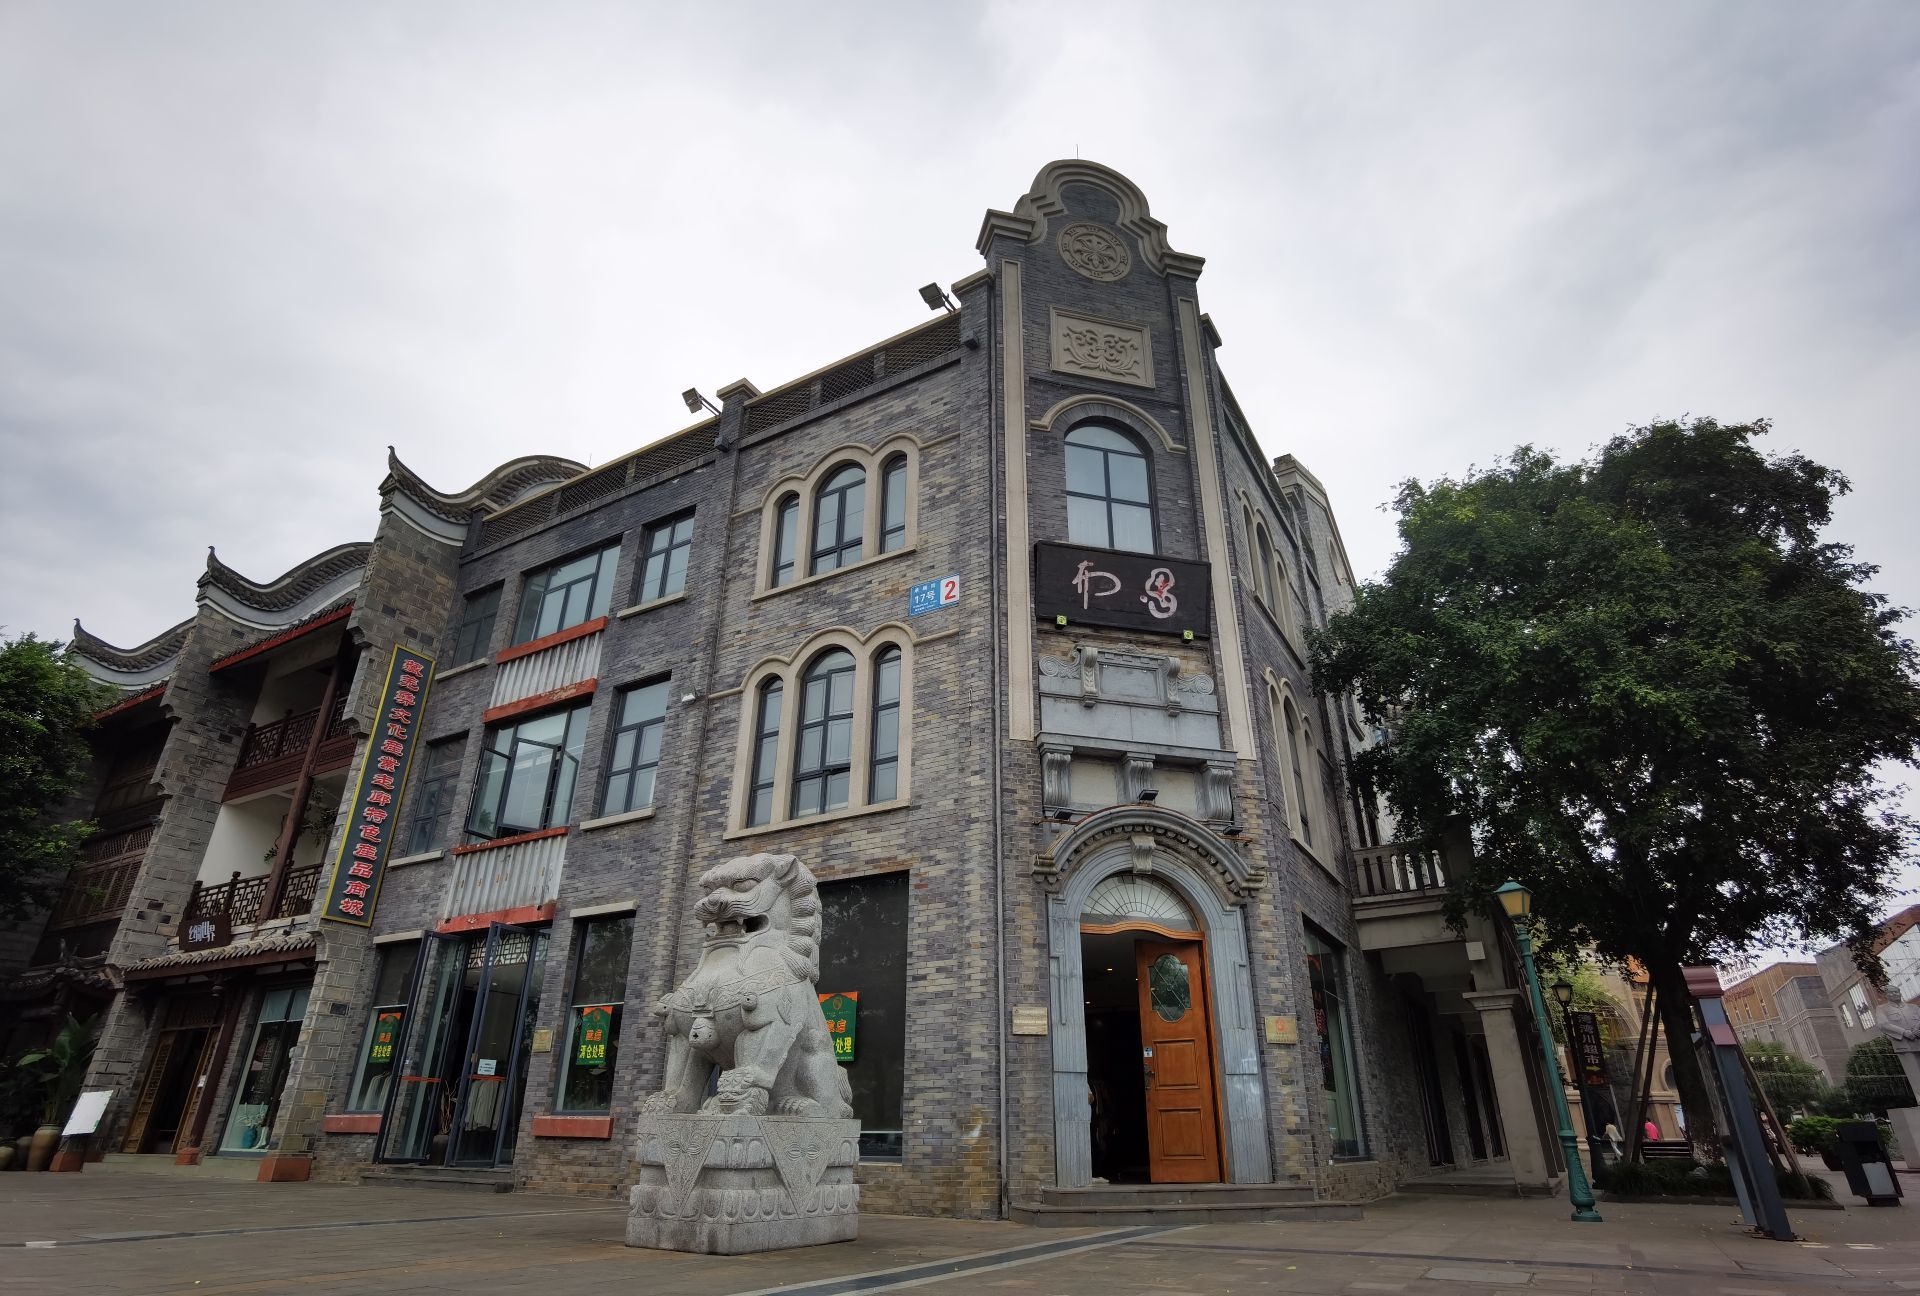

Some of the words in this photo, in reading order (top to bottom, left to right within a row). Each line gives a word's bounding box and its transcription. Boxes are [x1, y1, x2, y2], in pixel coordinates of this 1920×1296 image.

[944, 580, 957, 601] 2
[579, 1044, 605, 1059] 清仓处理
[833, 1036, 852, 1054] 处理
